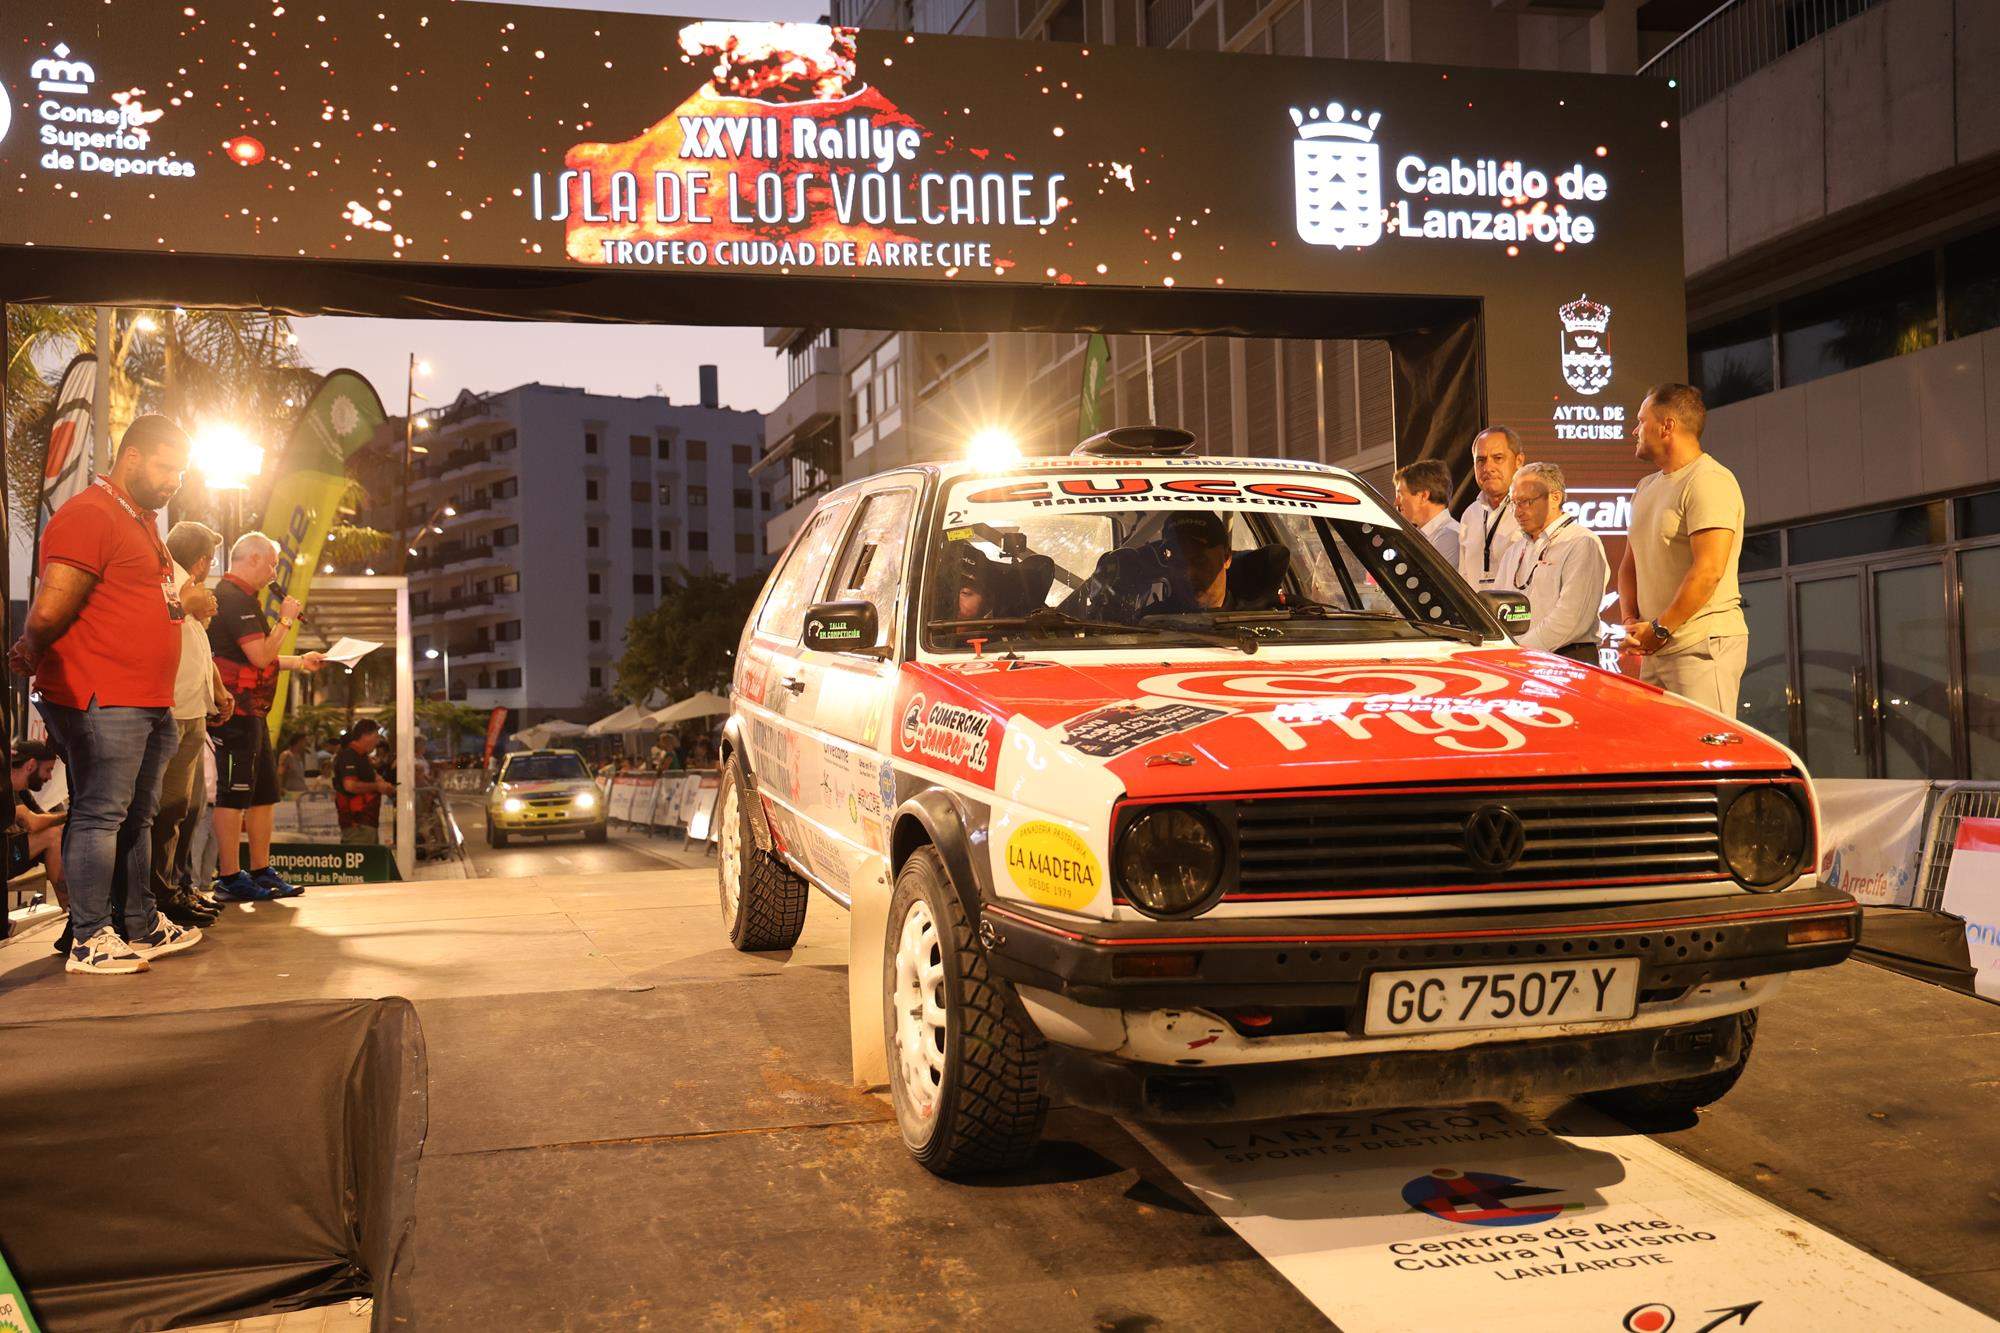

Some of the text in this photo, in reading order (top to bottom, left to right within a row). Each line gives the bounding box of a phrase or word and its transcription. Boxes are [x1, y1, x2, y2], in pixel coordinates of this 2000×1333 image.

[39, 100, 145, 130] Consejo
[40, 124, 151, 151] Superior
[679, 117, 921, 174] XXVII Rallye
[41, 149, 196, 178] de Deportes
[1396, 155, 1608, 202] Cabildo de
[532, 171, 1066, 225] ISLA DE LOS VOLCANES
[1398, 199, 1595, 244] Lanzarote
[602, 239, 992, 268] TROFEO CIUDAD DE ARRECIFE
[1552, 405, 1625, 421] AYTO. DE
[1554, 424, 1624, 440] TEGUISE
[966, 478, 1361, 506] CUCO
[1032, 495, 1318, 509] HAMBURGUESERIA
[929, 705, 989, 737] COMERCIAL
[269, 852, 365, 870] ampeonato BP
[1009, 845, 1094, 887] LA MADERA
[304, 872, 315, 882] de
[316, 872, 331, 883] Las
[332, 873, 364, 884] Palmas
[1028, 877, 1050, 894] DESDE
[1841, 870, 1889, 898] Arrecife
[1386, 967, 1617, 1025] GC 7507 Y
[1202, 1112, 1513, 1152] LANZAROT
[1224, 1124, 1574, 1165] SPORTS DESTINATION
[1388, 1217, 1686, 1256] Centros de Arte,
[1394, 1230, 1717, 1271] Cultura y Turismo
[1493, 1252, 1674, 1282] LANZAROTE
